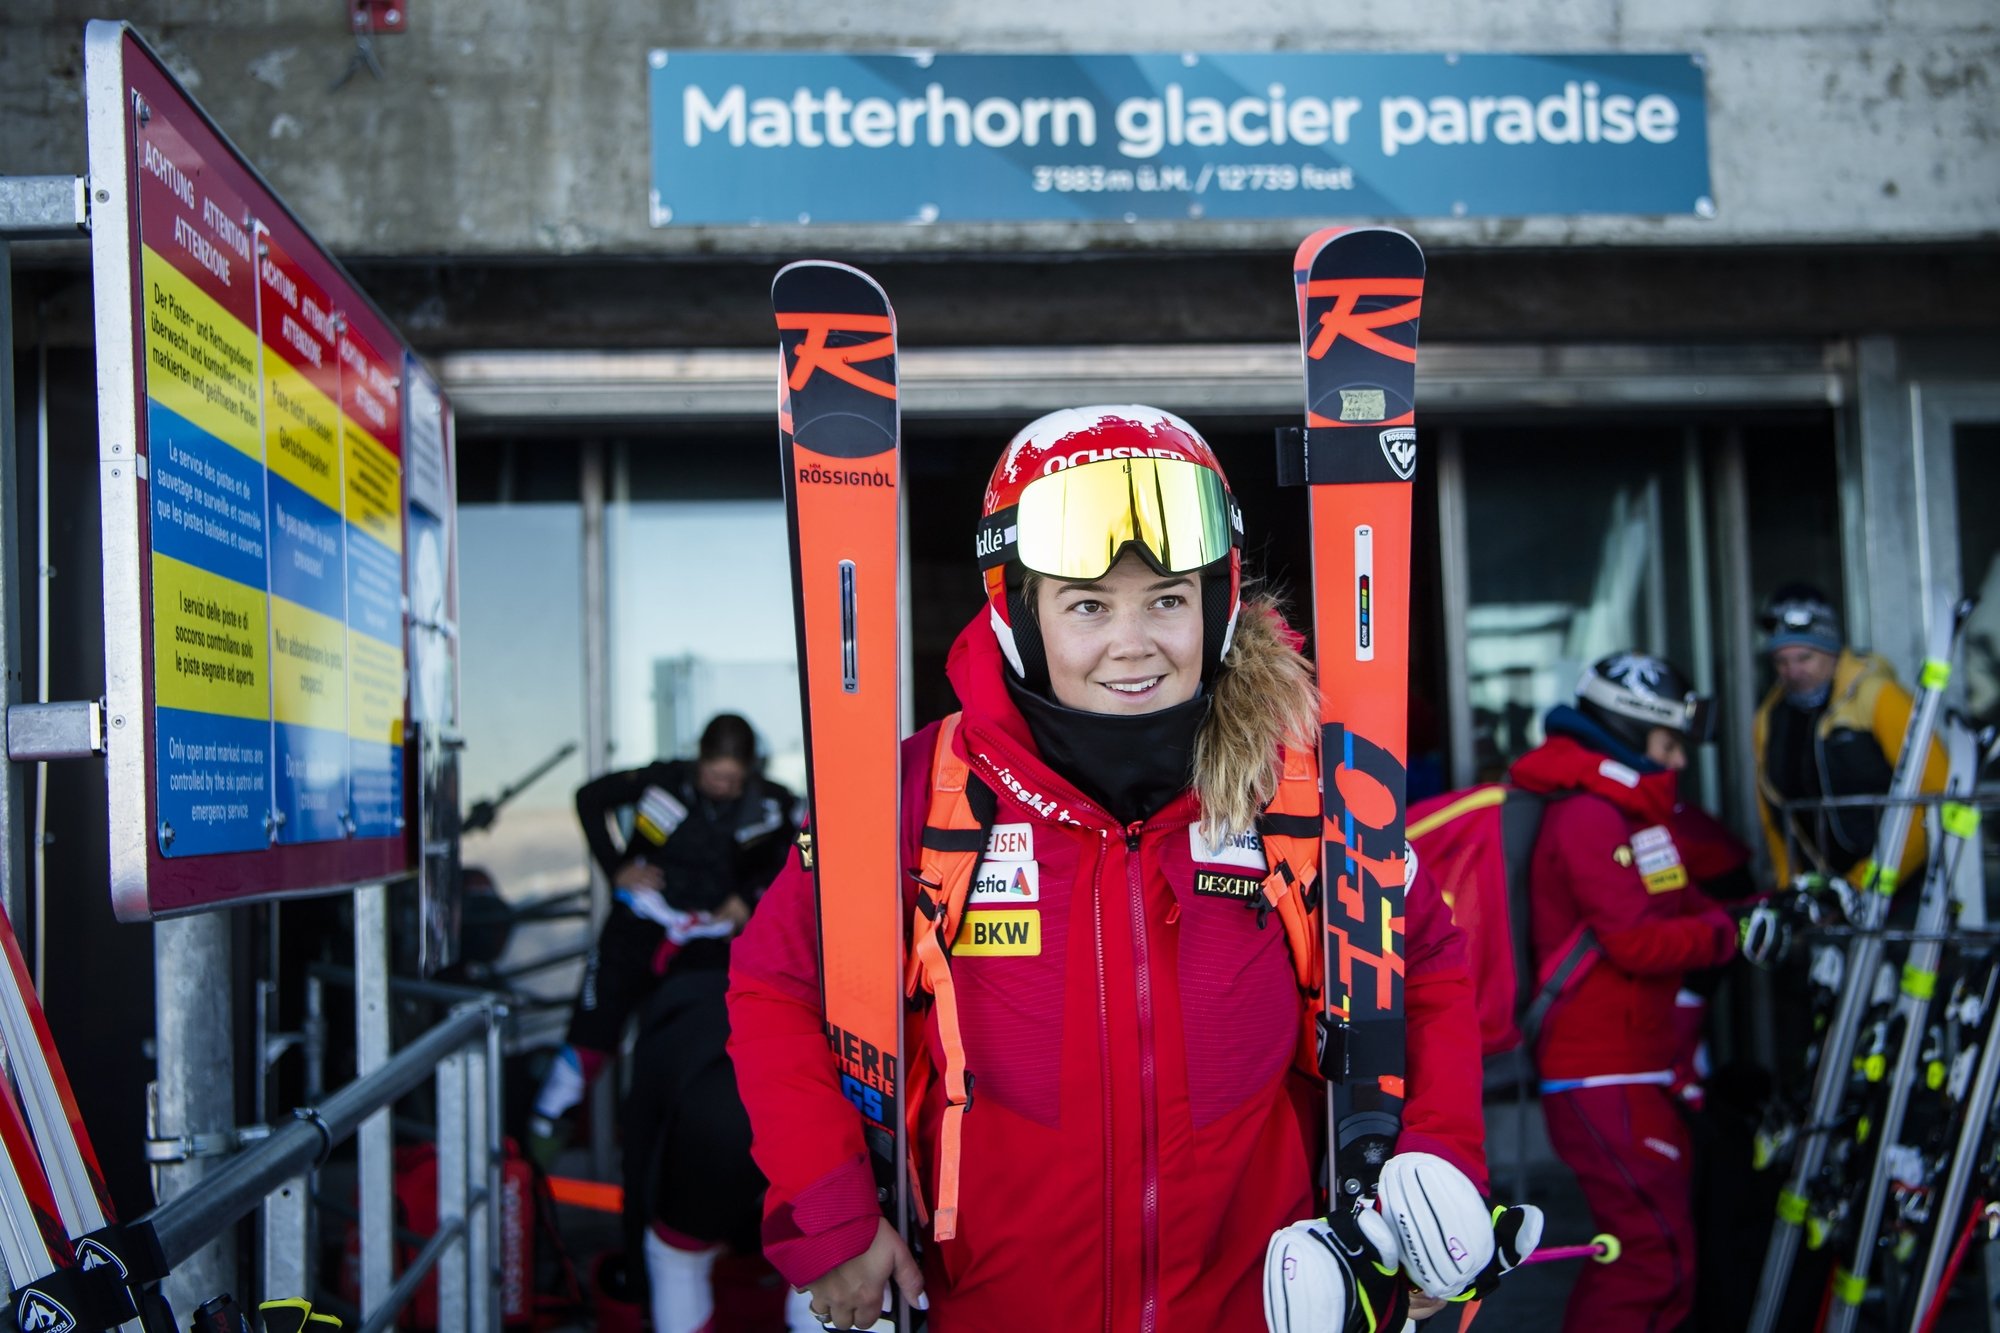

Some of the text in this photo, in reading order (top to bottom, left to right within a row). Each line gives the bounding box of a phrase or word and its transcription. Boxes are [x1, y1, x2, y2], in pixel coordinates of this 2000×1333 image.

[682, 79, 1680, 159] Matterhorn glacier paradise
[1301, 163, 1353, 190] feet
[145, 140, 250, 263] ACHTUNG ATTENTION
[175, 215, 231, 287] ATTENZIONE
[262, 258, 298, 310] ACHTUNG
[154, 282, 167, 311] Der
[169, 294, 194, 328] Pisten-
[196, 320, 208, 341] und
[151, 311, 189, 355] überwacht
[190, 343, 202, 365] und
[153, 347, 191, 385] markierten
[192, 373, 205, 393] und
[168, 438, 251, 500] Le service des pistes et de
[799, 469, 895, 488] ROSSIGNOL
[157, 468, 193, 503] sauvetage
[194, 486, 202, 504] ne
[203, 492, 229, 518] surveille
[230, 504, 237, 521] et
[157, 499, 263, 559] que les pistes balisées et ouvertes
[179, 589, 249, 631] I servizi delle piste e di
[175, 625, 254, 659] soccorso controllano solo
[175, 649, 255, 689] le piste segnate ed aperte
[169, 736, 263, 766] Only open and marked runs are
[170, 769, 264, 796] controlled by the ski patrol and
[191, 804, 249, 826] emergency service
[1225, 830, 1263, 852] swis
[975, 874, 1006, 893] etia
[974, 921, 1029, 945] BKW
[841, 1073, 883, 1122] GS
